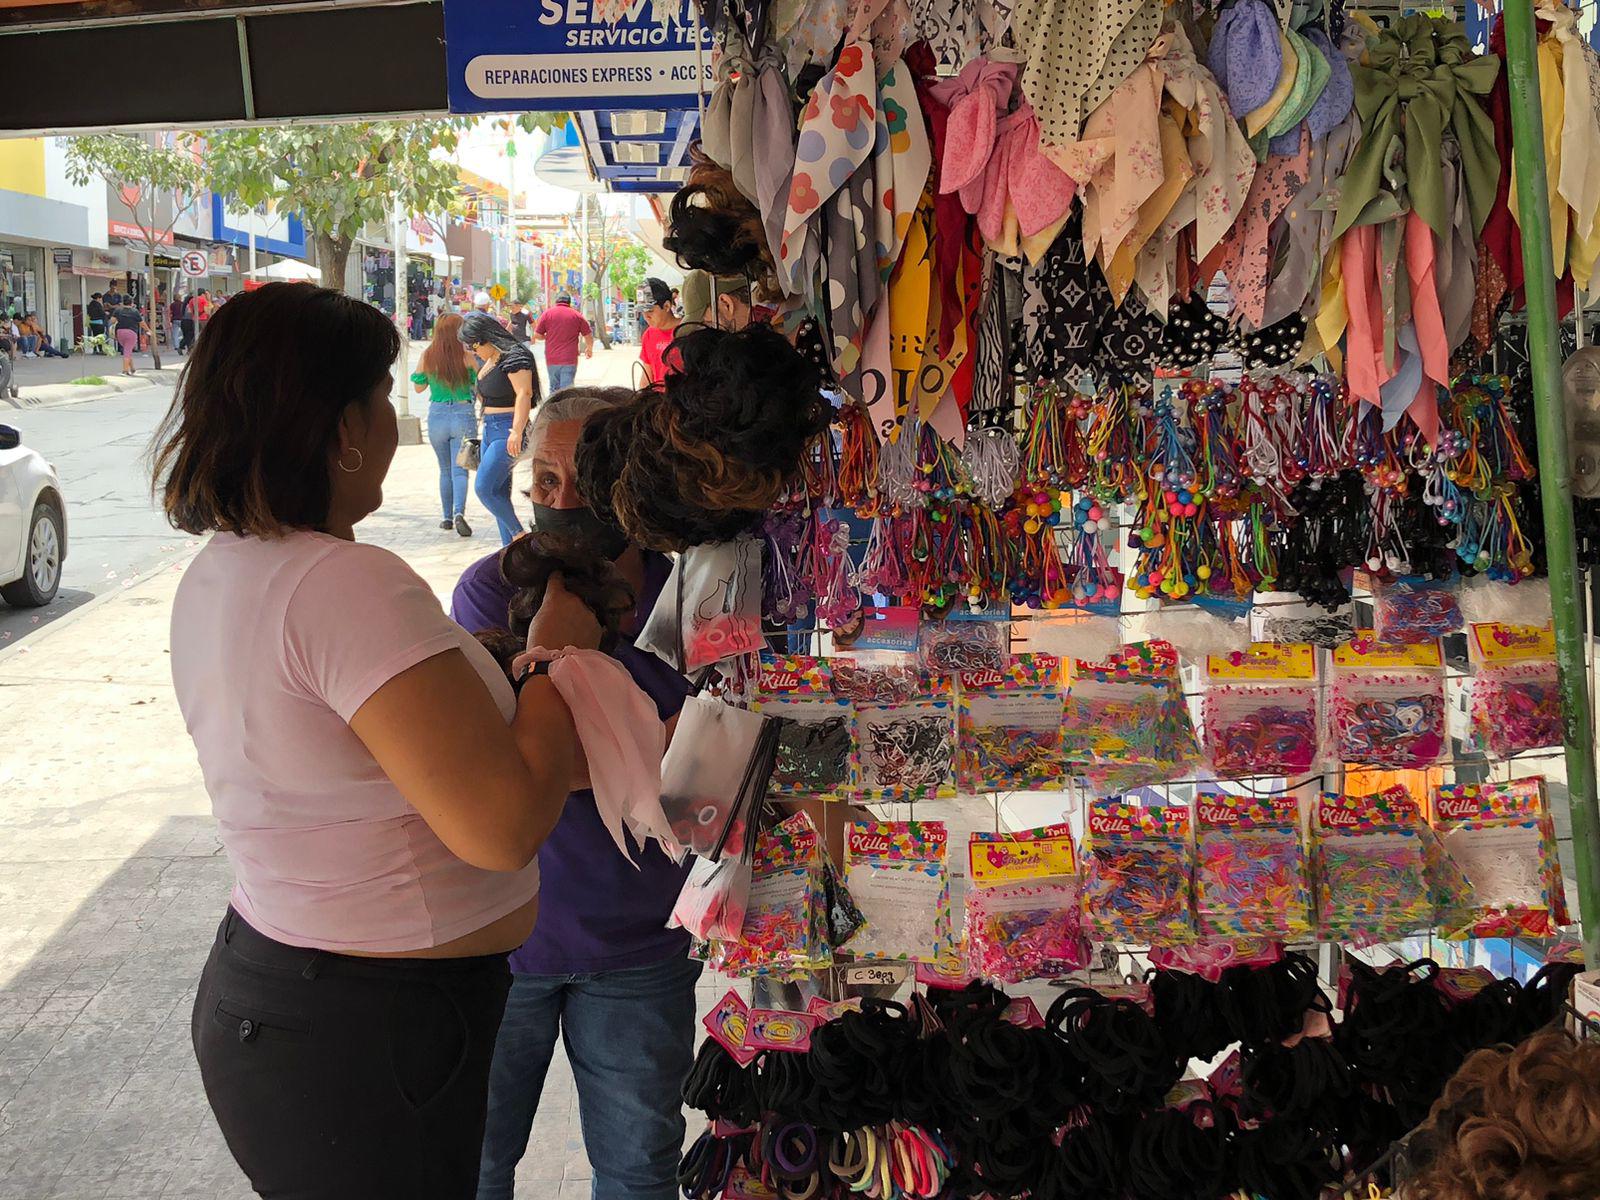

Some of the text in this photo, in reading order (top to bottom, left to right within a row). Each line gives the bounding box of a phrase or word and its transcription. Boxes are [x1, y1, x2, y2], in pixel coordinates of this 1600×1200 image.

[565, 28, 668, 46] SERVICIO
[485, 68, 588, 85] REPARACIONES
[592, 66, 653, 83] EXPRESS
[761, 672, 799, 689] Killa
[961, 669, 1003, 686] Killa
[1199, 805, 1239, 822] Killa
[1320, 807, 1359, 824] Killa
[1438, 799, 1479, 816] Killa
[1091, 816, 1131, 832] Killa
[851, 834, 889, 851] Killa
